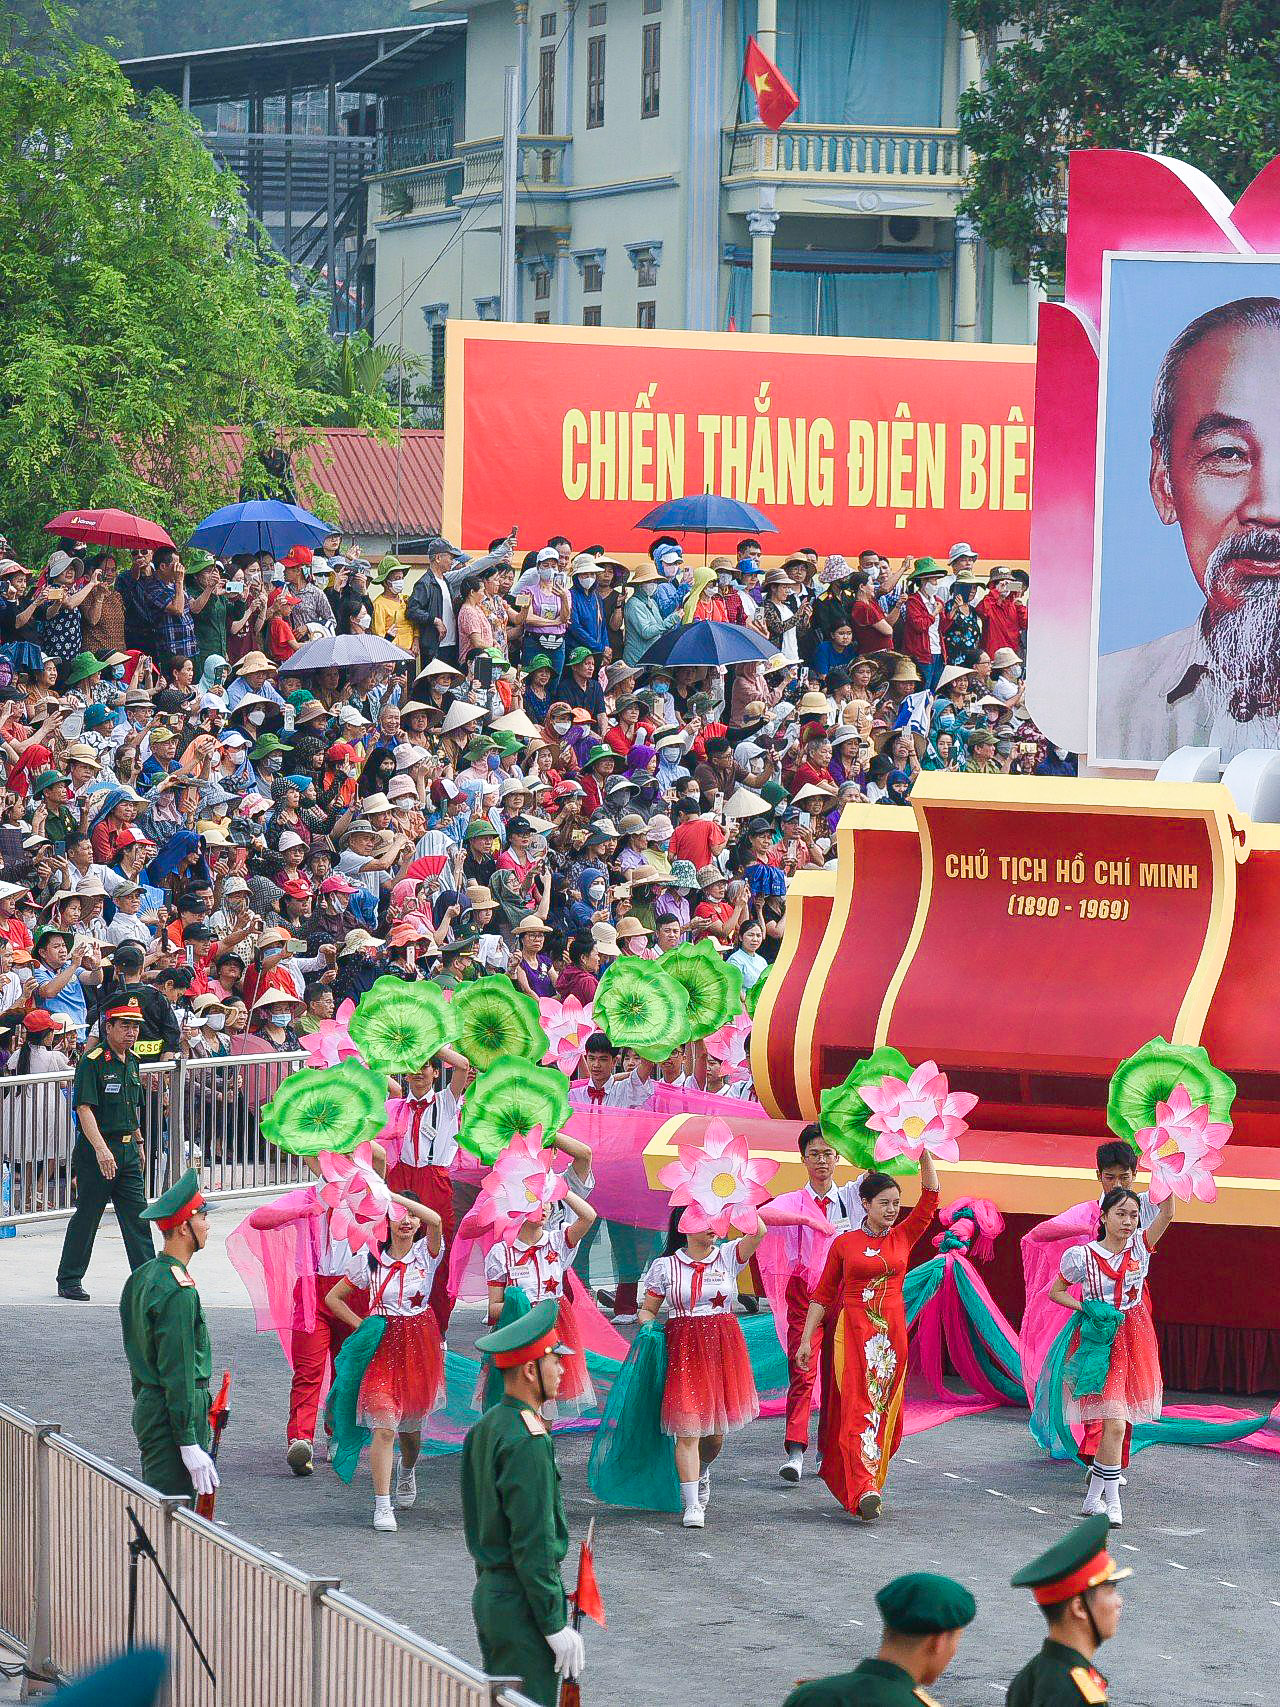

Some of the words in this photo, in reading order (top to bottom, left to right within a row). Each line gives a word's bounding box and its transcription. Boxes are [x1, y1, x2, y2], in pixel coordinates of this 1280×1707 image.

[561, 382, 685, 502] CHIẾN
[699, 381, 835, 507] THẮNG
[846, 401, 946, 529] ĐIỆN
[959, 406, 1035, 511] BIÊ
[945, 848, 989, 880] CHỦ
[998, 856, 1047, 885] TỊCH
[1056, 851, 1085, 884] HỒ
[1094, 857, 1131, 886] CHÍ
[1139, 862, 1198, 889] MINH
[1007, 894, 1060, 917] (1890
[1079, 898, 1130, 921] 1969)
